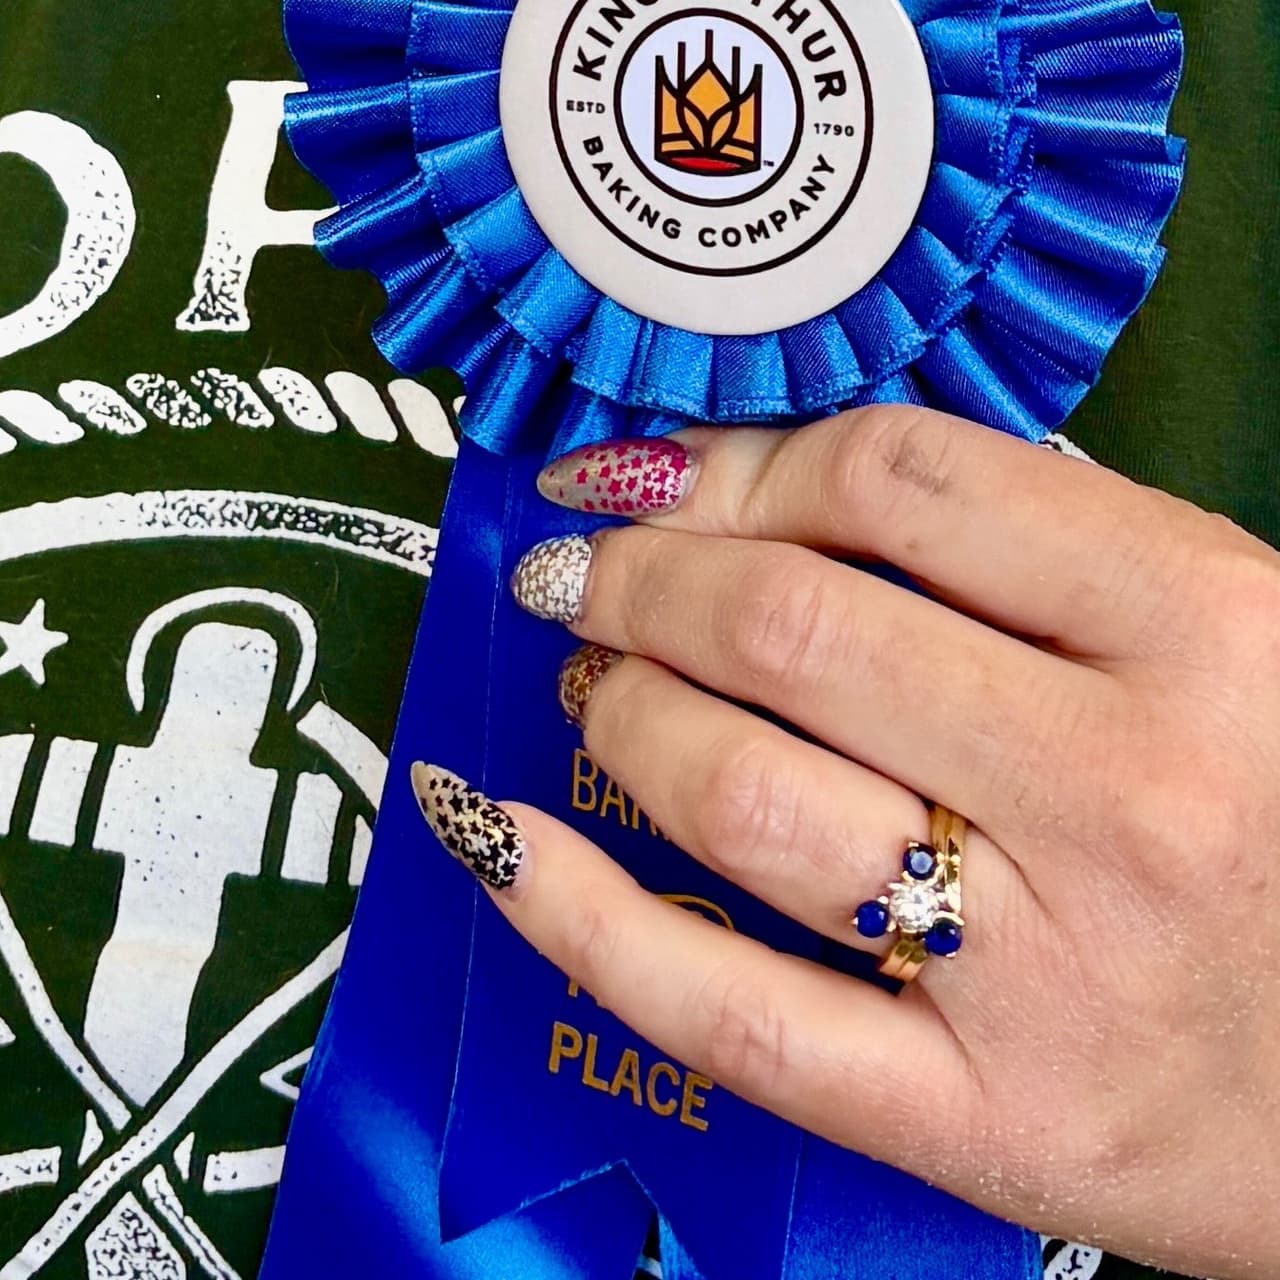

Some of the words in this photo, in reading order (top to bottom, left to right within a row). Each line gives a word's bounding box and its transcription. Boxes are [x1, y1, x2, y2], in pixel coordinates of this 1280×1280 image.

[566, 99, 606, 114] ESTD
[813, 122, 855, 137] 1790
[582, 135, 682, 240] BAKING
[697, 153, 835, 248] COMPANY
[548, 1020, 714, 1132] PLACE
